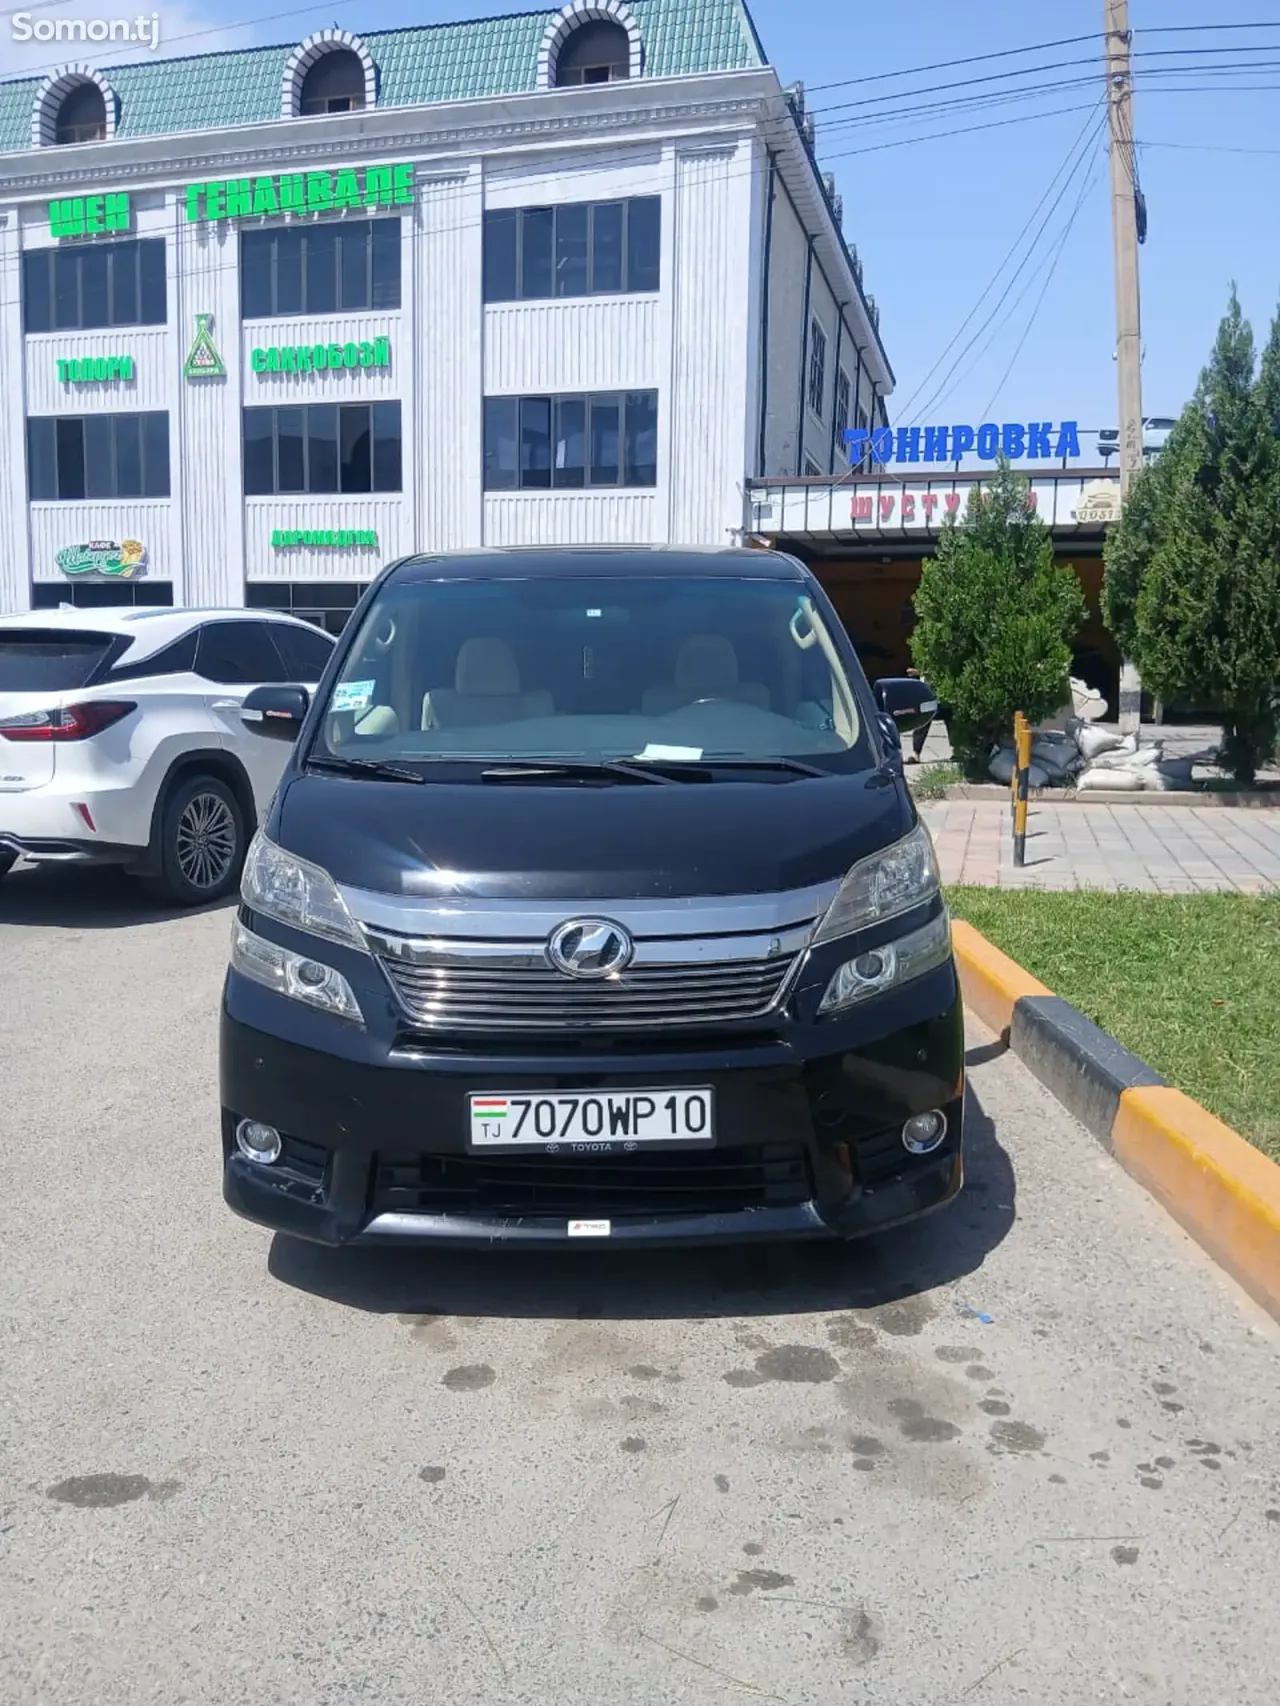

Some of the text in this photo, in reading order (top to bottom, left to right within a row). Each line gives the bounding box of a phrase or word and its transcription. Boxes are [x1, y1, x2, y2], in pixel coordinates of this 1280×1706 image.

[48, 163, 415, 238] ШЕН ГЕНАЦВАЛЕ
[842, 421, 1081, 464] ТОНИРОВКА
[481, 1123, 501, 1139] TJ
[510, 1095, 707, 1139] 7070WP10
[571, 1142, 613, 1152] TOYOTA
